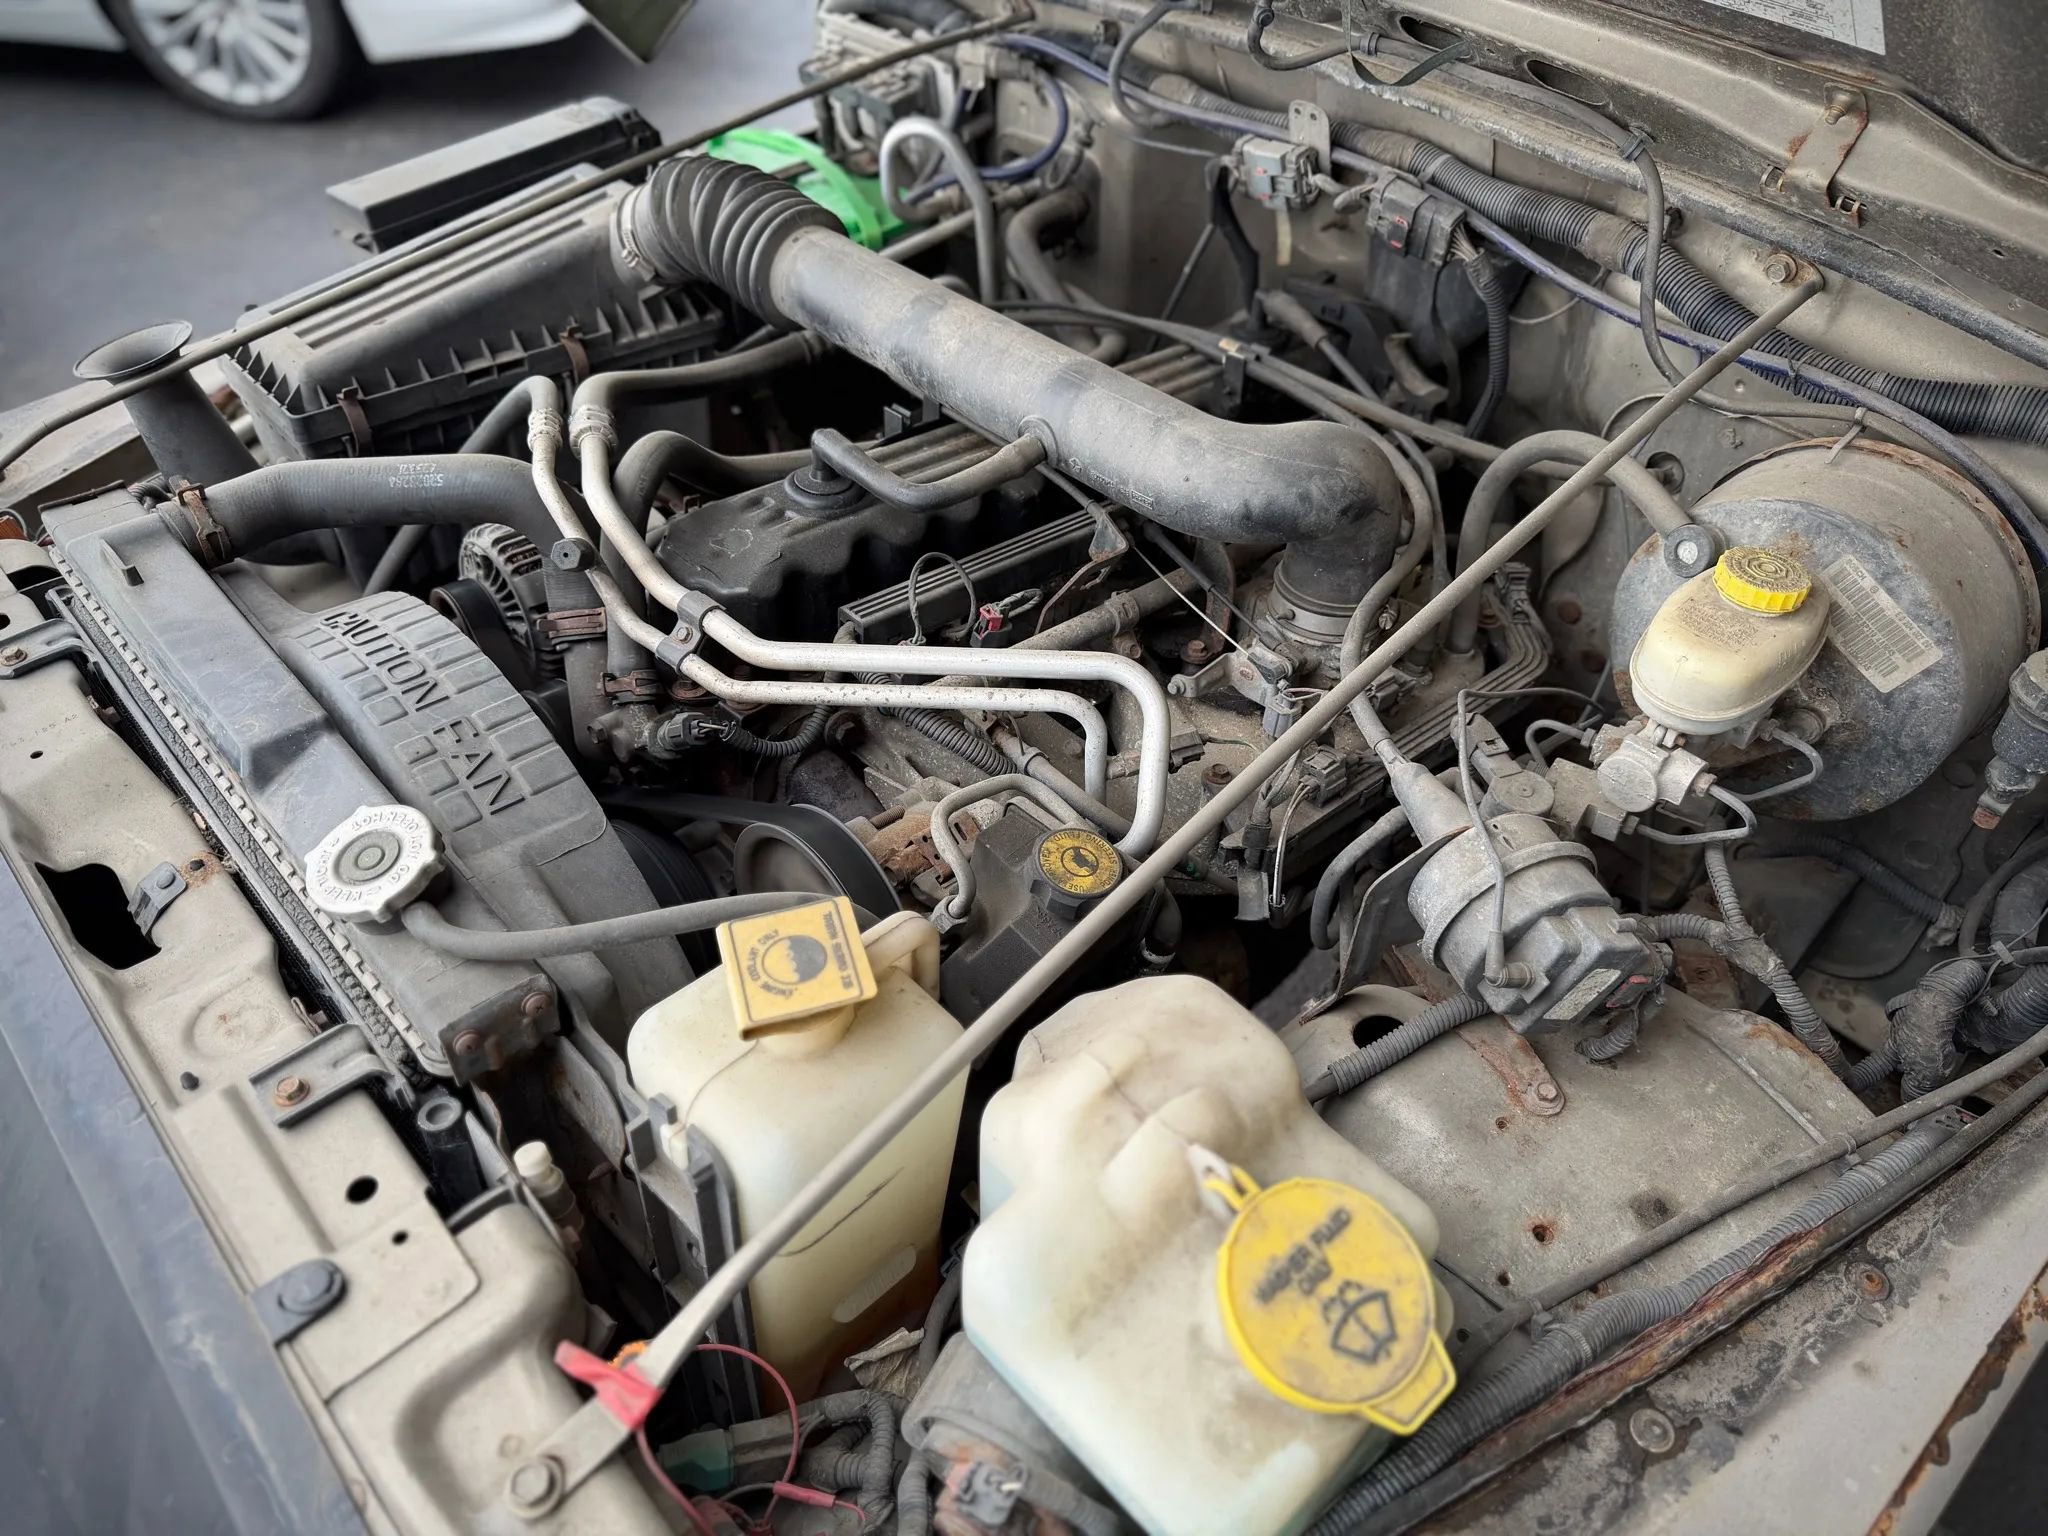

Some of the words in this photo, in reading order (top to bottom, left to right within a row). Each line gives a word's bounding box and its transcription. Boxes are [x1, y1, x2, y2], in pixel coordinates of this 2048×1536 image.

[320, 611, 450, 712] CAUTION
[433, 717, 526, 816] FAN
[352, 811, 384, 832] HOT
[388, 811, 419, 832] OPEN
[1054, 831, 1080, 841] FLUID
[1086, 833, 1117, 865] STEERING
[324, 885, 363, 902] KEEP
[1068, 882, 1085, 892] USE
[747, 947, 760, 982] COOLANT
[757, 929, 780, 946] ONLY
[1310, 1207, 1351, 1244] FLUID
